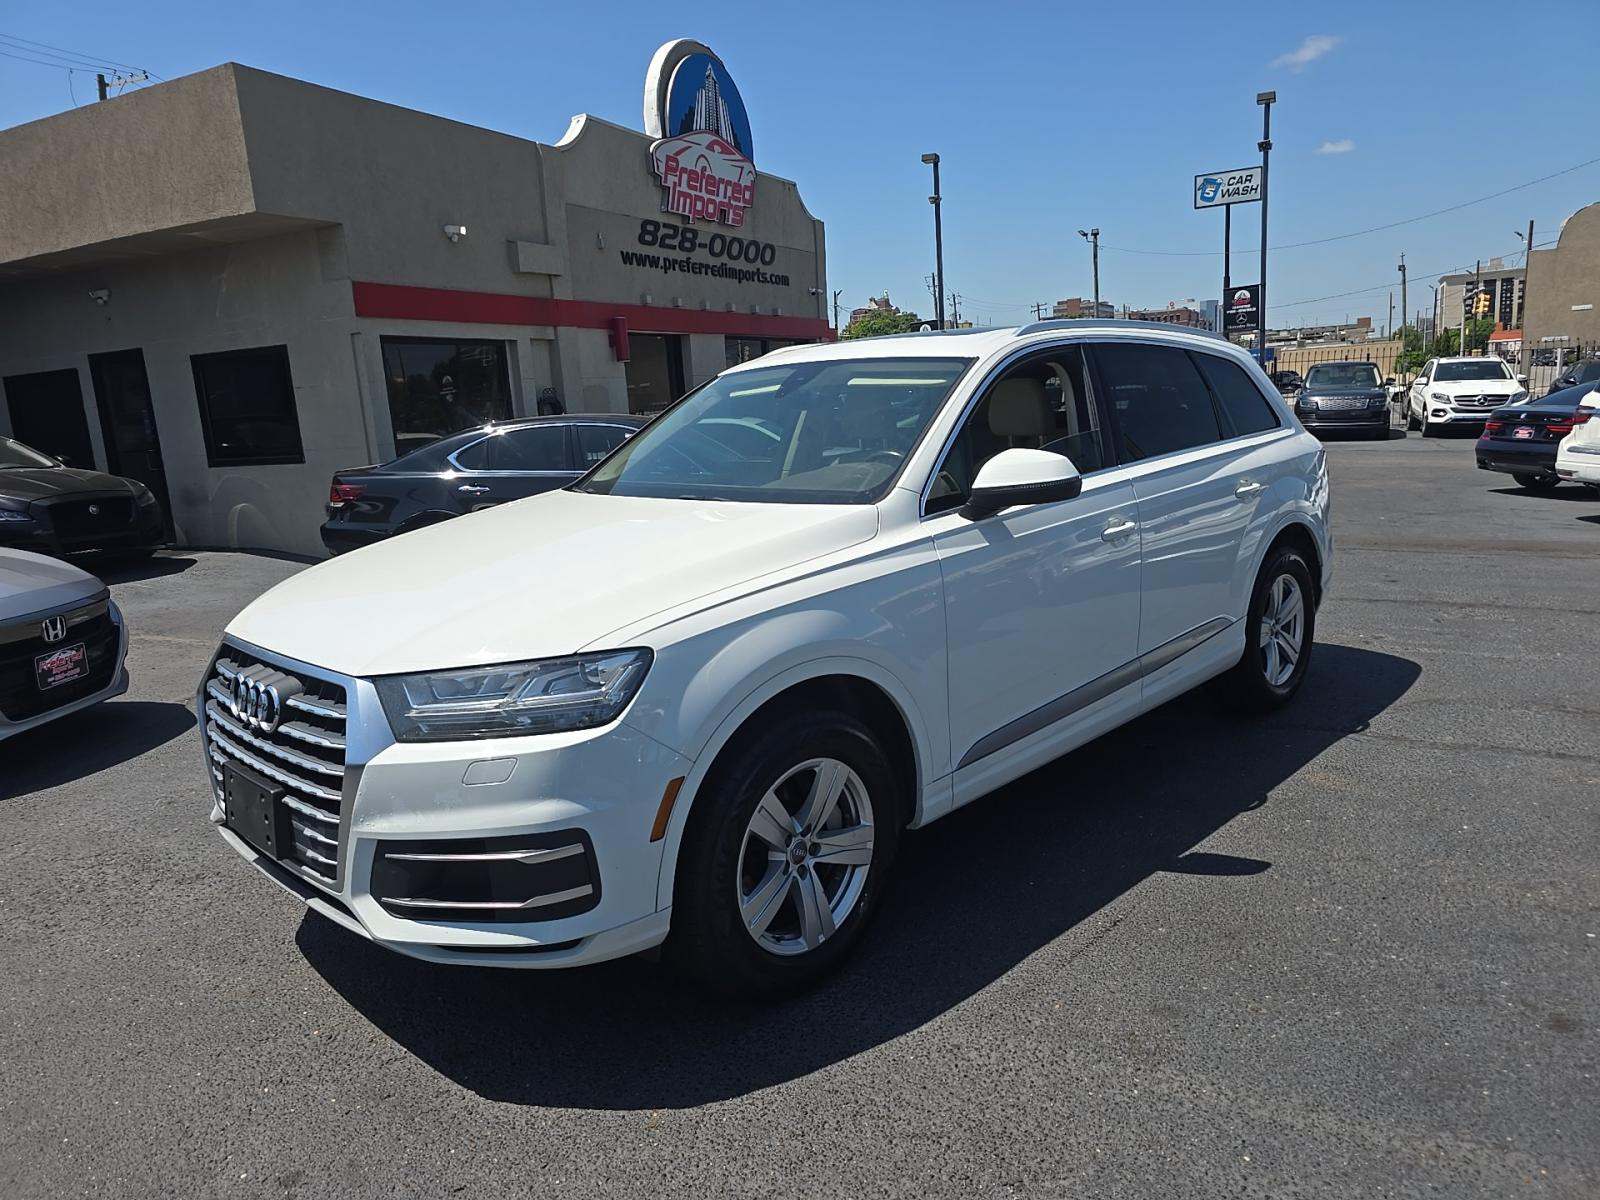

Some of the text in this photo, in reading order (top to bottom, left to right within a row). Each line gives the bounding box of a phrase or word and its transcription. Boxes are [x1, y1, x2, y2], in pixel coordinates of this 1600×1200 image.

[663, 154, 754, 207] Preferred
[1220, 184, 1259, 199] WASH
[1227, 174, 1254, 187] CAR
[669, 181, 745, 226] Imports
[637, 218, 776, 266] 828-0000
[619, 250, 790, 287] www.preferredimports.com
